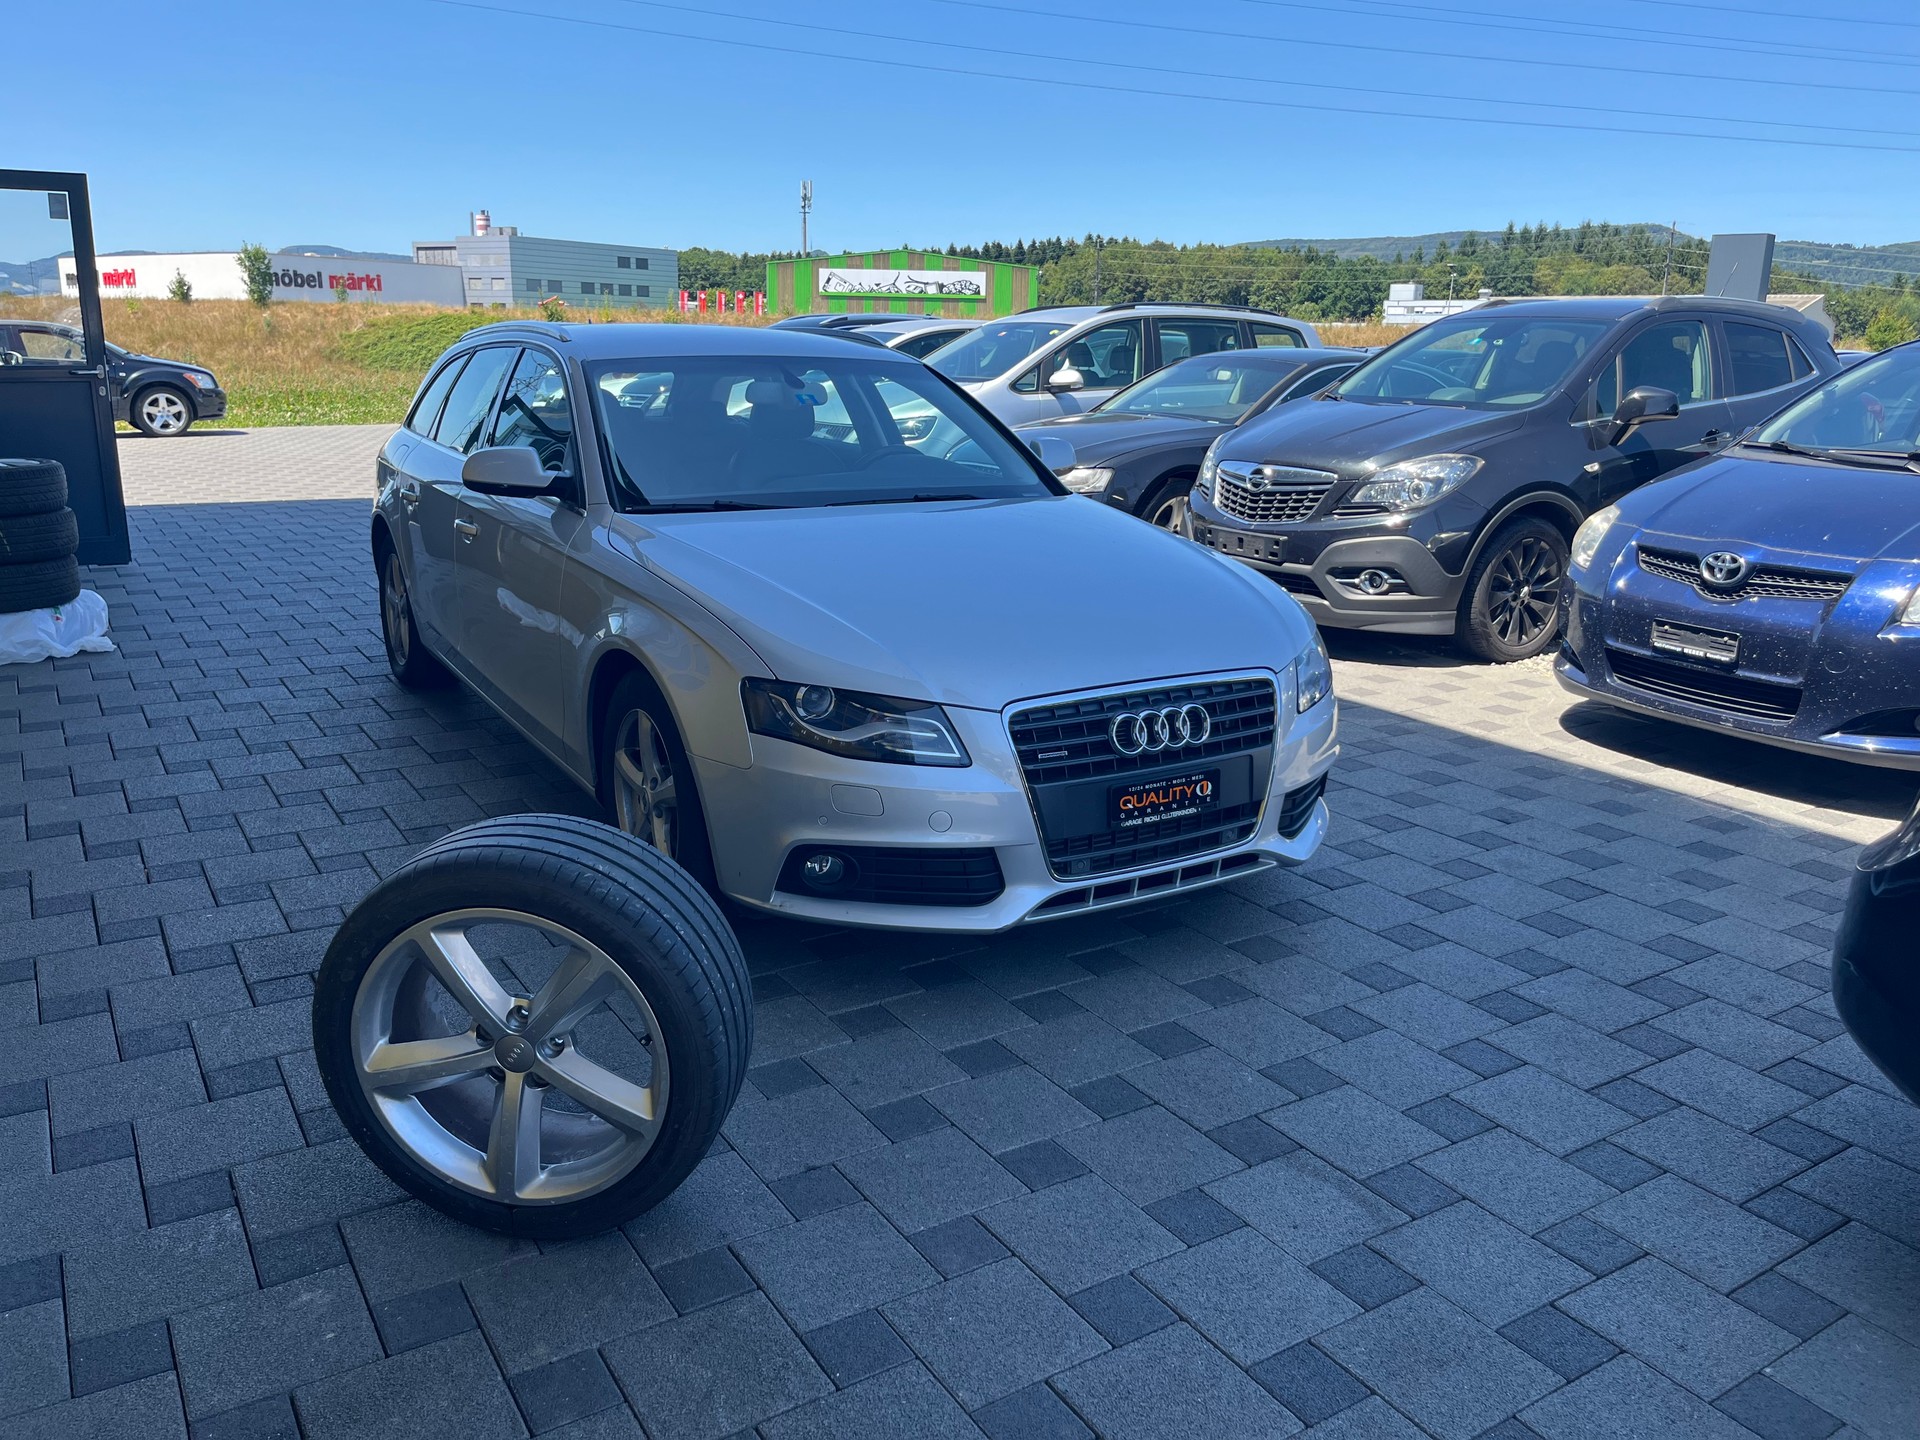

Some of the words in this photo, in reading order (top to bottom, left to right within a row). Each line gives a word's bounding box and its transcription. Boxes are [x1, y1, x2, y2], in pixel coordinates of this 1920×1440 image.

[328, 272, 383, 292] märki
[1145, 781, 1167, 789] MONATE
[1119, 783, 1195, 810] QUALITY
[1120, 796, 1211, 818] GARANTIE
[1120, 817, 1143, 828] GARAGE
